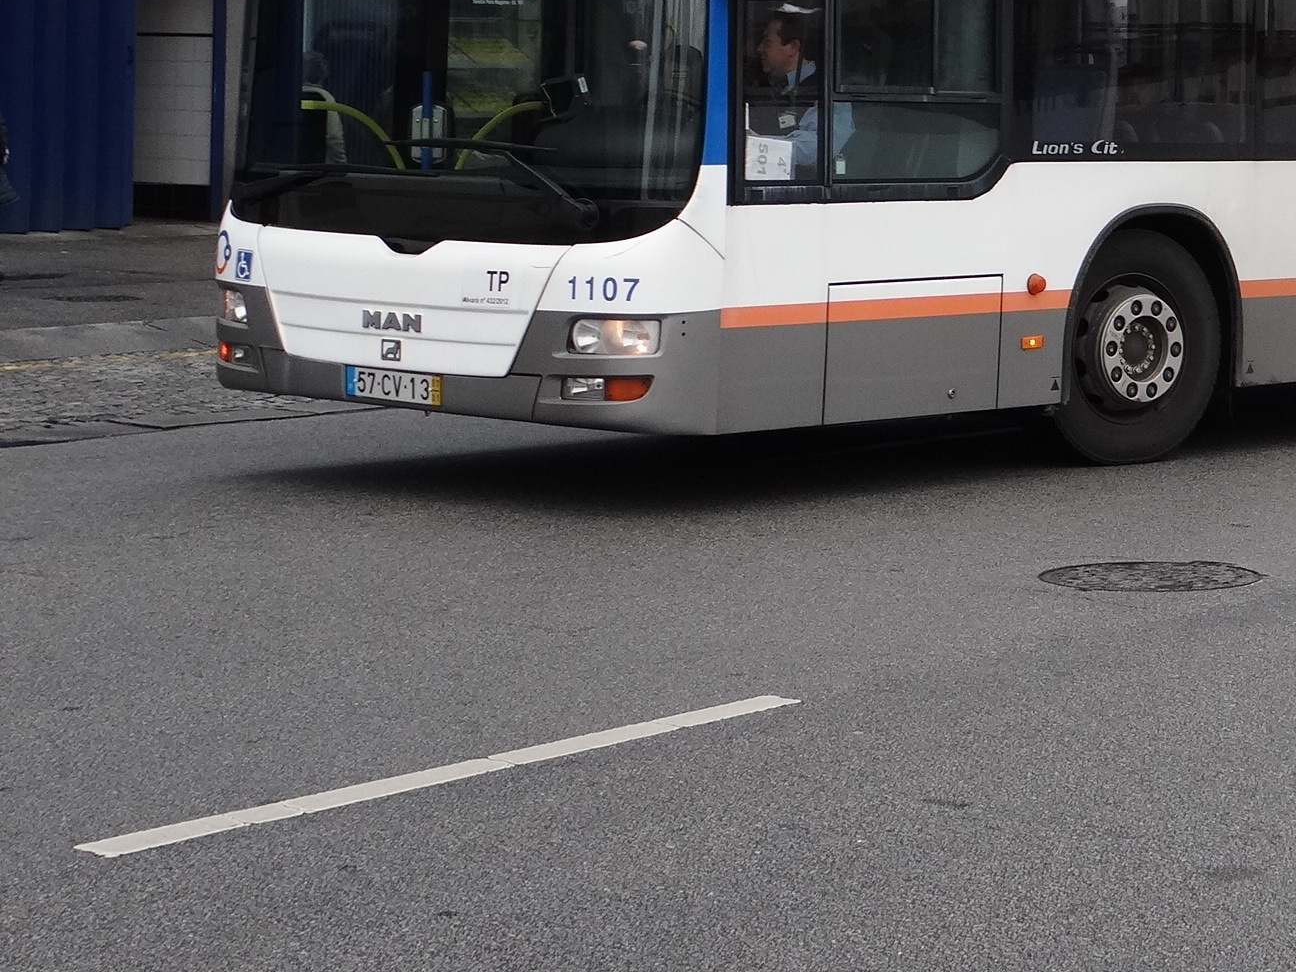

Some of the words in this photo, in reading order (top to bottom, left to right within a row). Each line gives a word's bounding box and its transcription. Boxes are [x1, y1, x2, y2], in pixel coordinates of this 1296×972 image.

[1031, 140, 1084, 155] Lion's
[1091, 139, 1125, 155] Cit
[486, 270, 510, 292] TP
[568, 275, 640, 302] 1107
[362, 309, 422, 333] MAN
